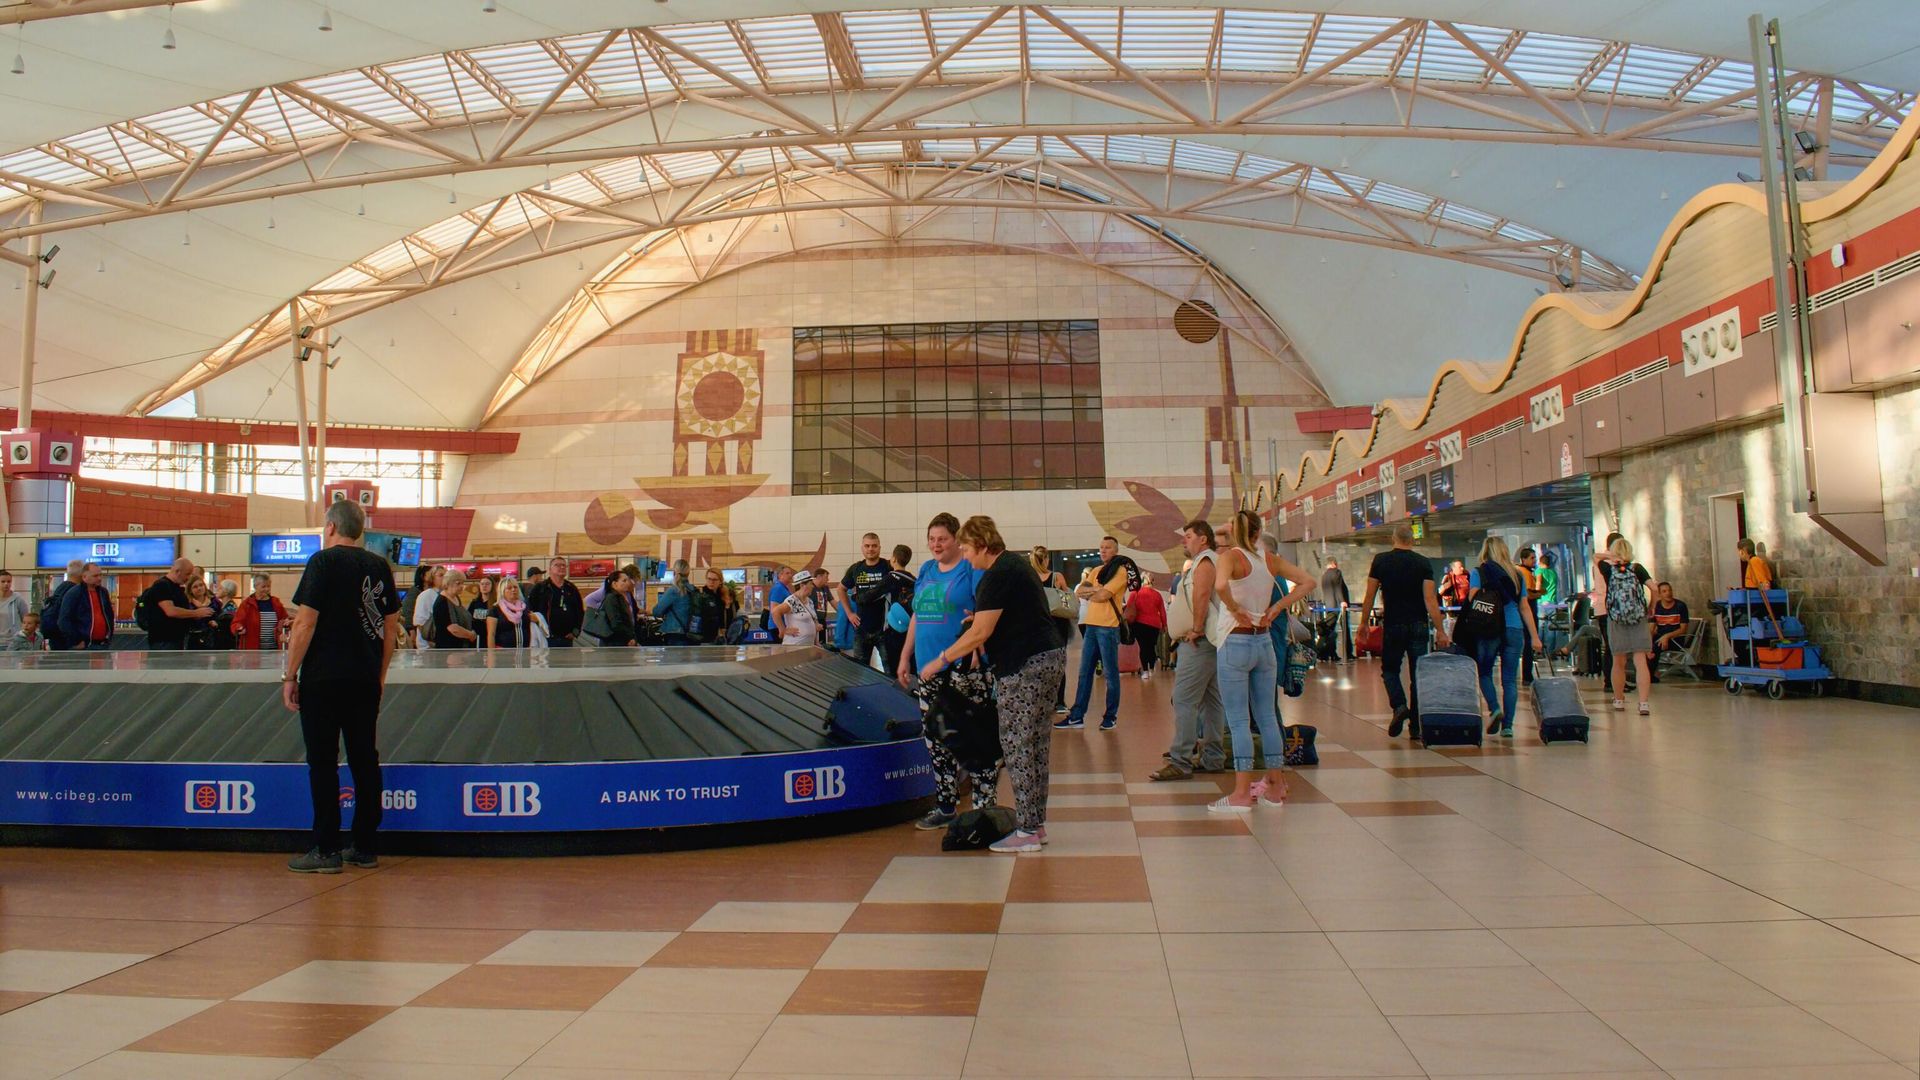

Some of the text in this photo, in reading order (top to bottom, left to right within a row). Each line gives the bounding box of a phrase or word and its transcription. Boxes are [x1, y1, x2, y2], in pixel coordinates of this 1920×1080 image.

[92, 543, 119, 557] CIB
[273, 539, 301, 554] CIB
[1472, 599, 1495, 615] VANS
[784, 765, 846, 804] CIB
[16, 789, 133, 804] www.cibeg.com
[185, 780, 256, 814] CIB
[463, 781, 542, 817] CIB
[600, 785, 740, 803] A BANK TO TRUST
